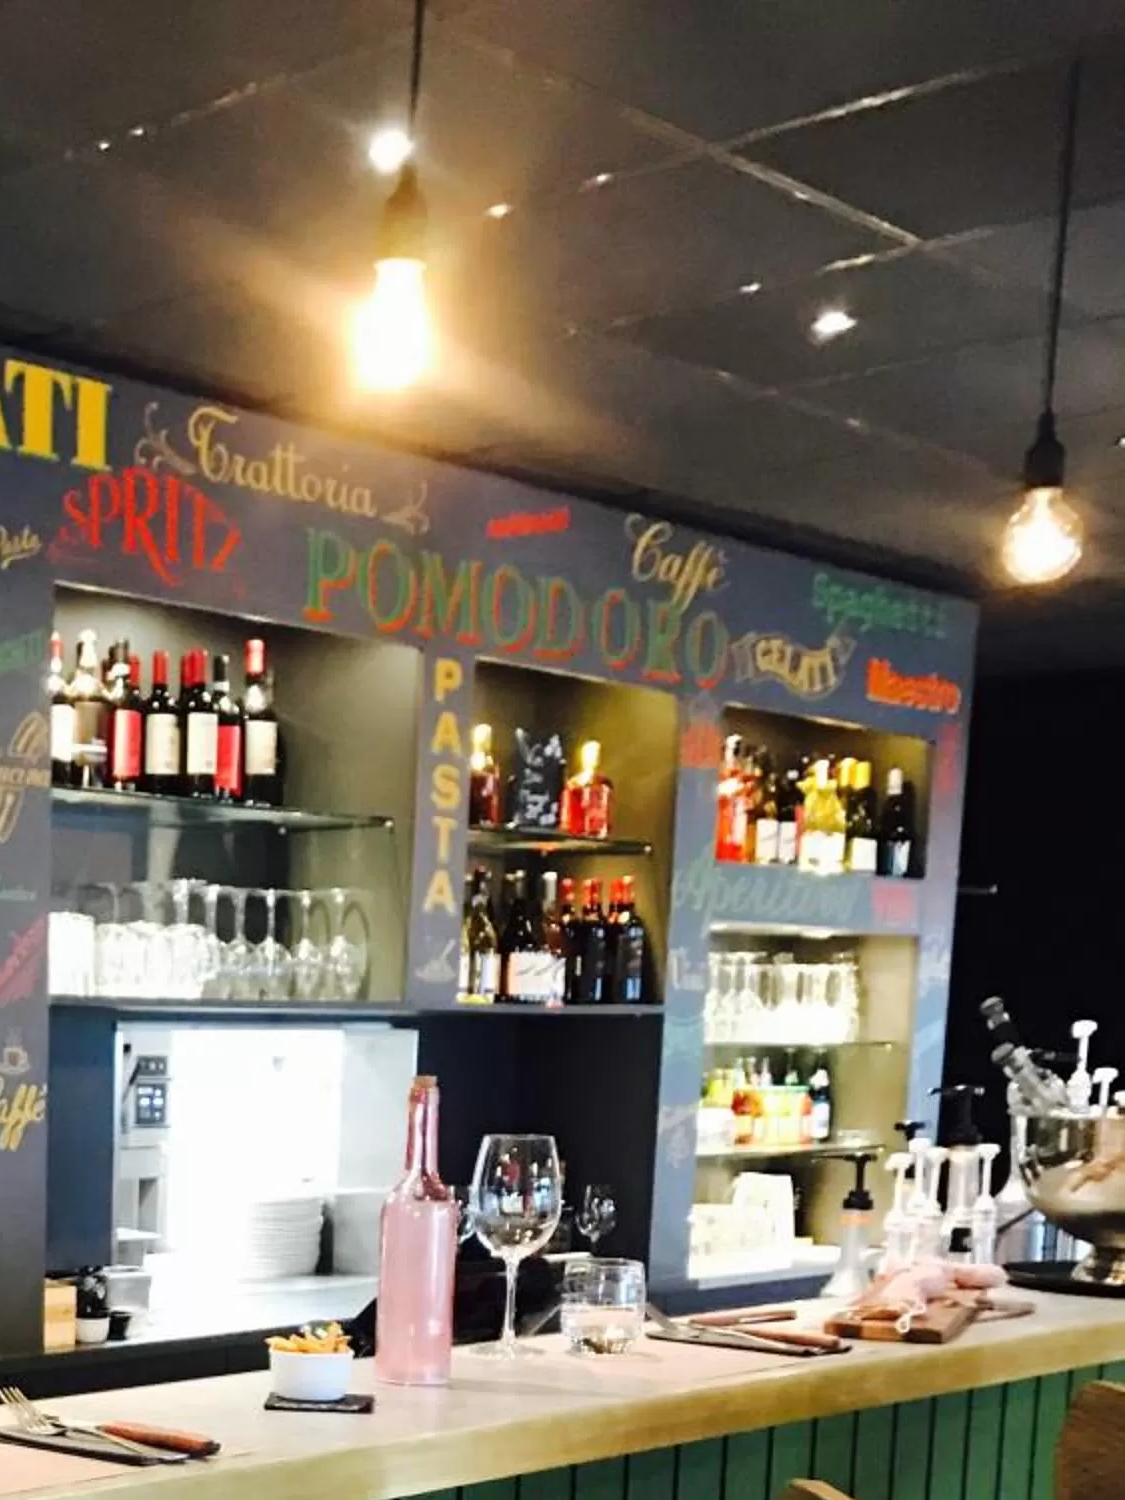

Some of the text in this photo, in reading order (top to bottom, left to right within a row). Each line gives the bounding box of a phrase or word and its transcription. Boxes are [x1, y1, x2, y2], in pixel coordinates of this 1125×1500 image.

[188, 406, 378, 517] Trattoria
[302, 528, 727, 690] POMODORO
[423, 656, 464, 917] PASTA
